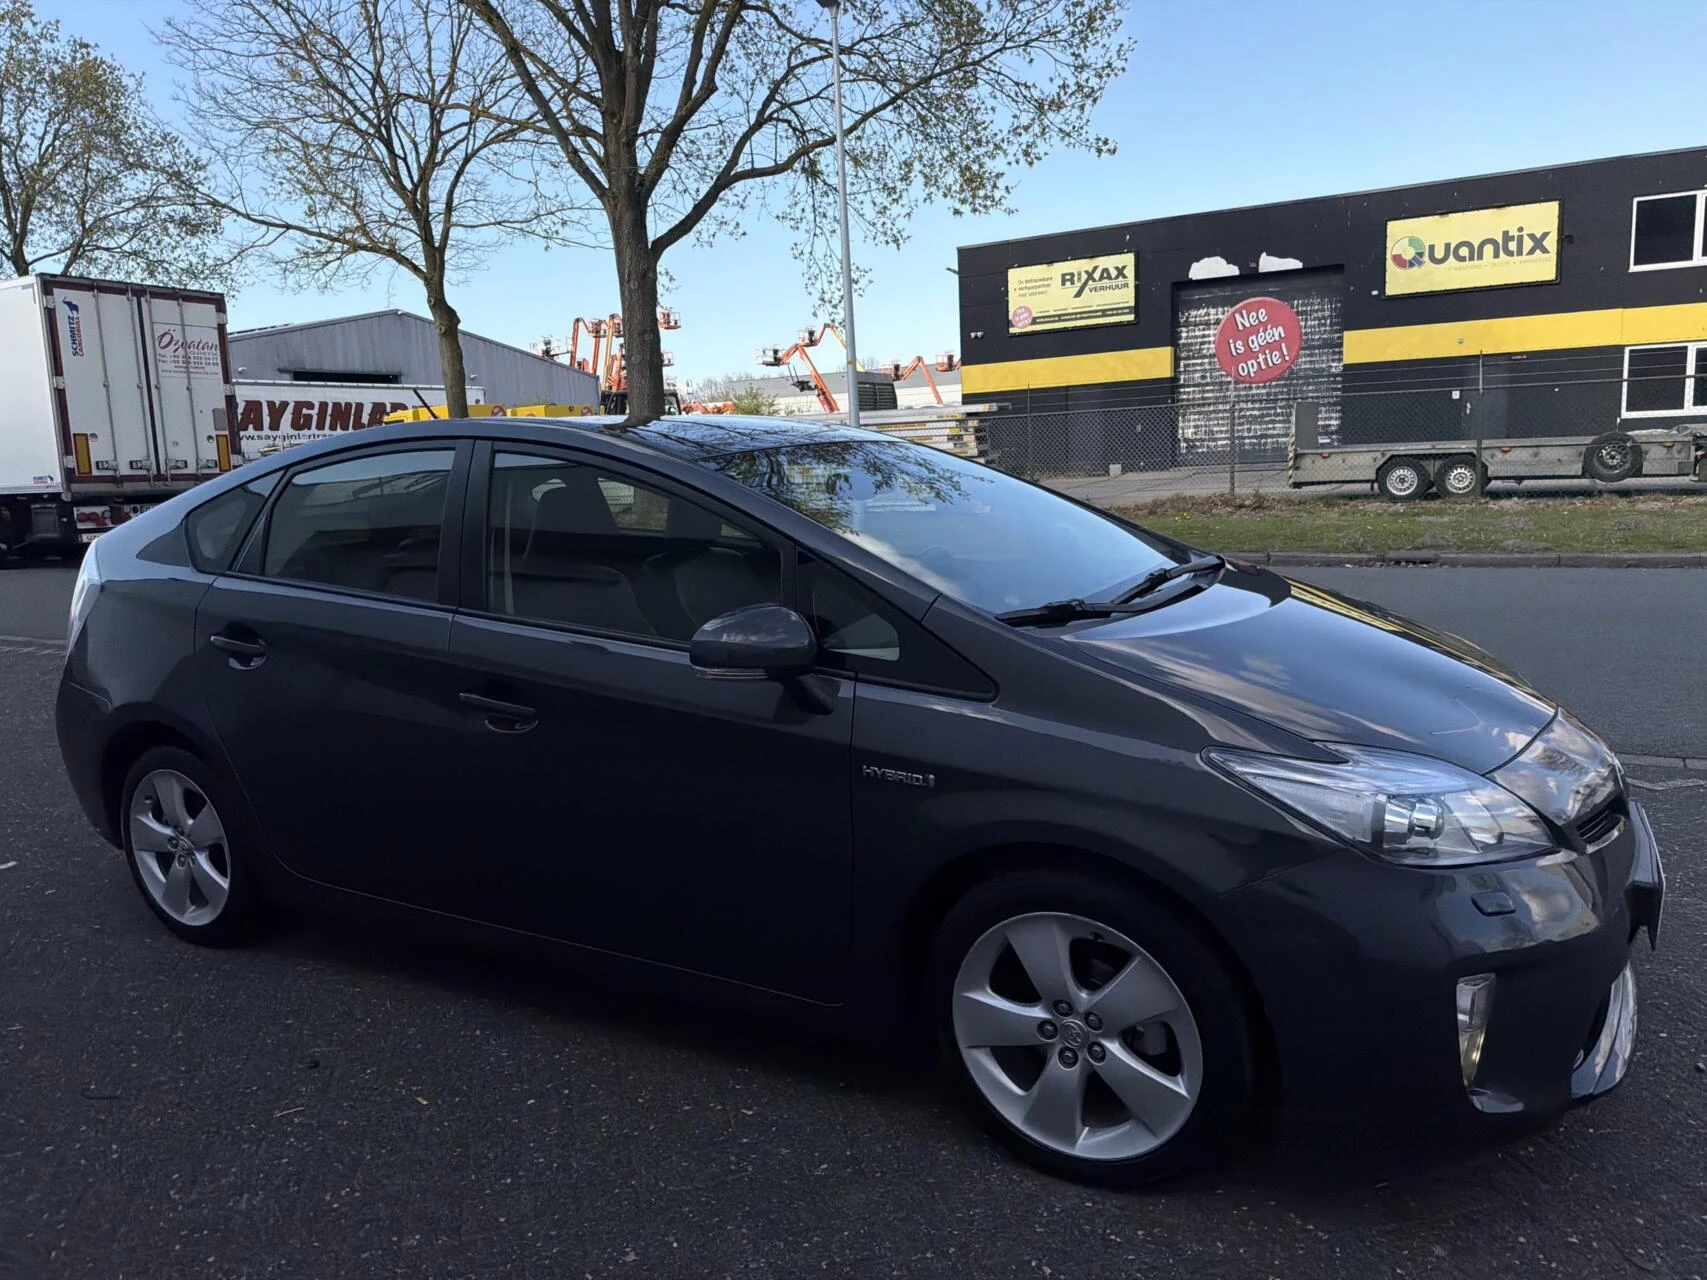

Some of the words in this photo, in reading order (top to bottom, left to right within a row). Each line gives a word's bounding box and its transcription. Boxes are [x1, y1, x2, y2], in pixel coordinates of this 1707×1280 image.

[1391, 226, 1552, 270] Quantix
[1089, 282, 1129, 293] VERHUUR
[1234, 308, 1268, 331] Nee
[68, 315, 78, 357] SCHMITZ
[1228, 338, 1245, 357] is
[1248, 324, 1286, 352] géén
[862, 765, 924, 787] HYBRID
